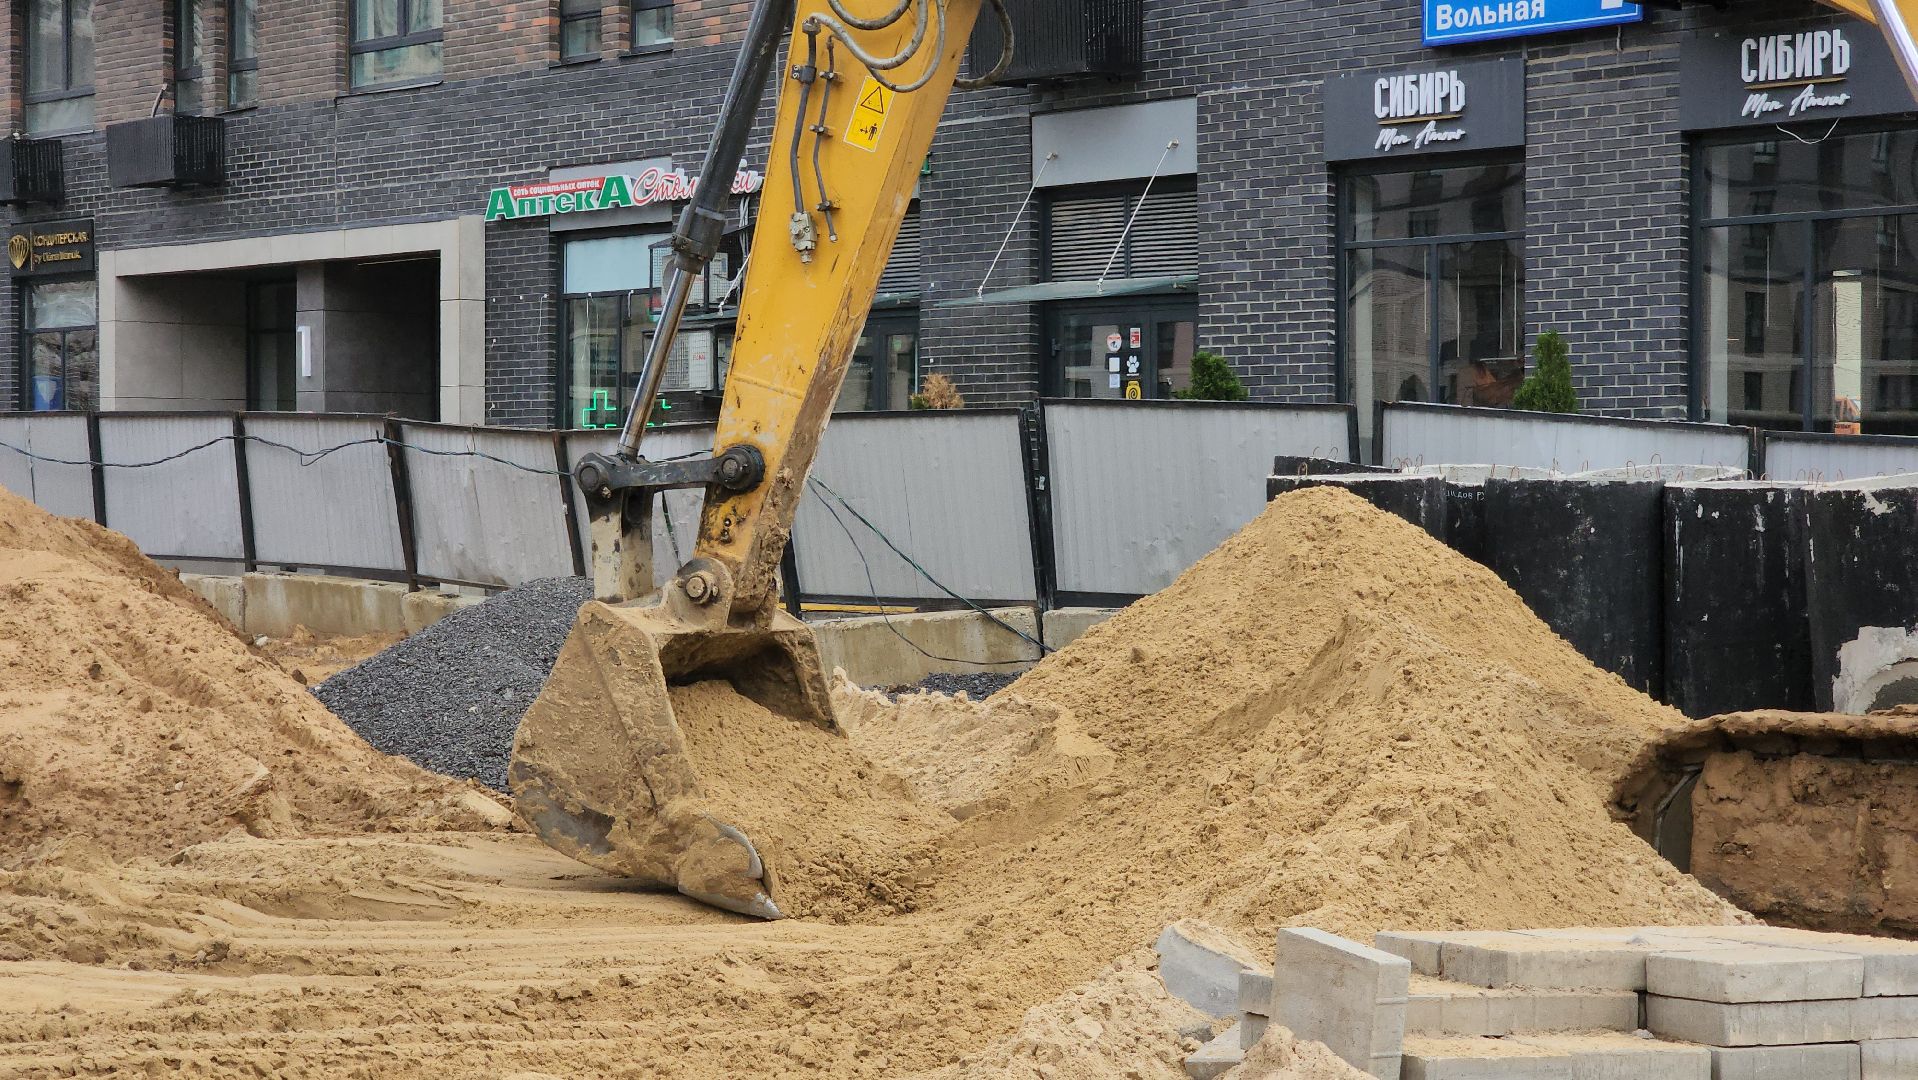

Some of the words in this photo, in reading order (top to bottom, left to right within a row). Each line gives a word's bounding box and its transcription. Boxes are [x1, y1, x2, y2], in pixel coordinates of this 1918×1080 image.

[1436, 0, 1545, 31] Вольная
[1741, 29, 1850, 82] СИБИРЬ
[1374, 70, 1466, 118] СИБИРЬ
